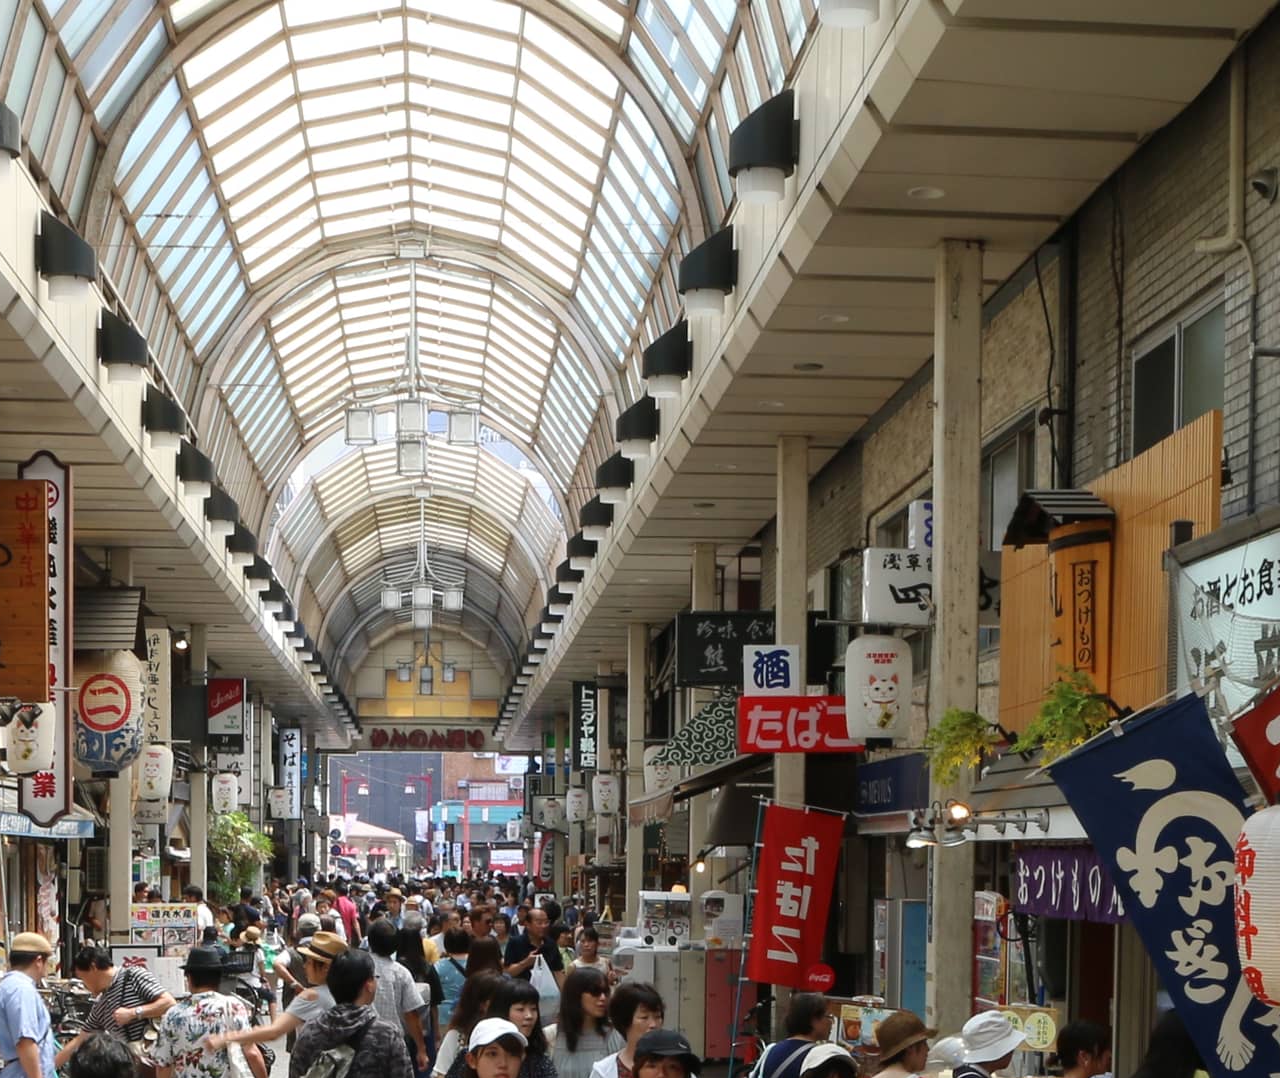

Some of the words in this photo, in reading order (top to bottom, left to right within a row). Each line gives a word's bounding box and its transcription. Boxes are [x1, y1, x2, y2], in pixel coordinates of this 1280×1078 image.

[15, 492, 40, 588] 中華そば
[696, 620, 737, 639] 珍味
[1077, 569, 1091, 664] おつけもの
[753, 649, 791, 689] 酒
[747, 700, 860, 749] たばこ
[283, 734, 297, 767] そば
